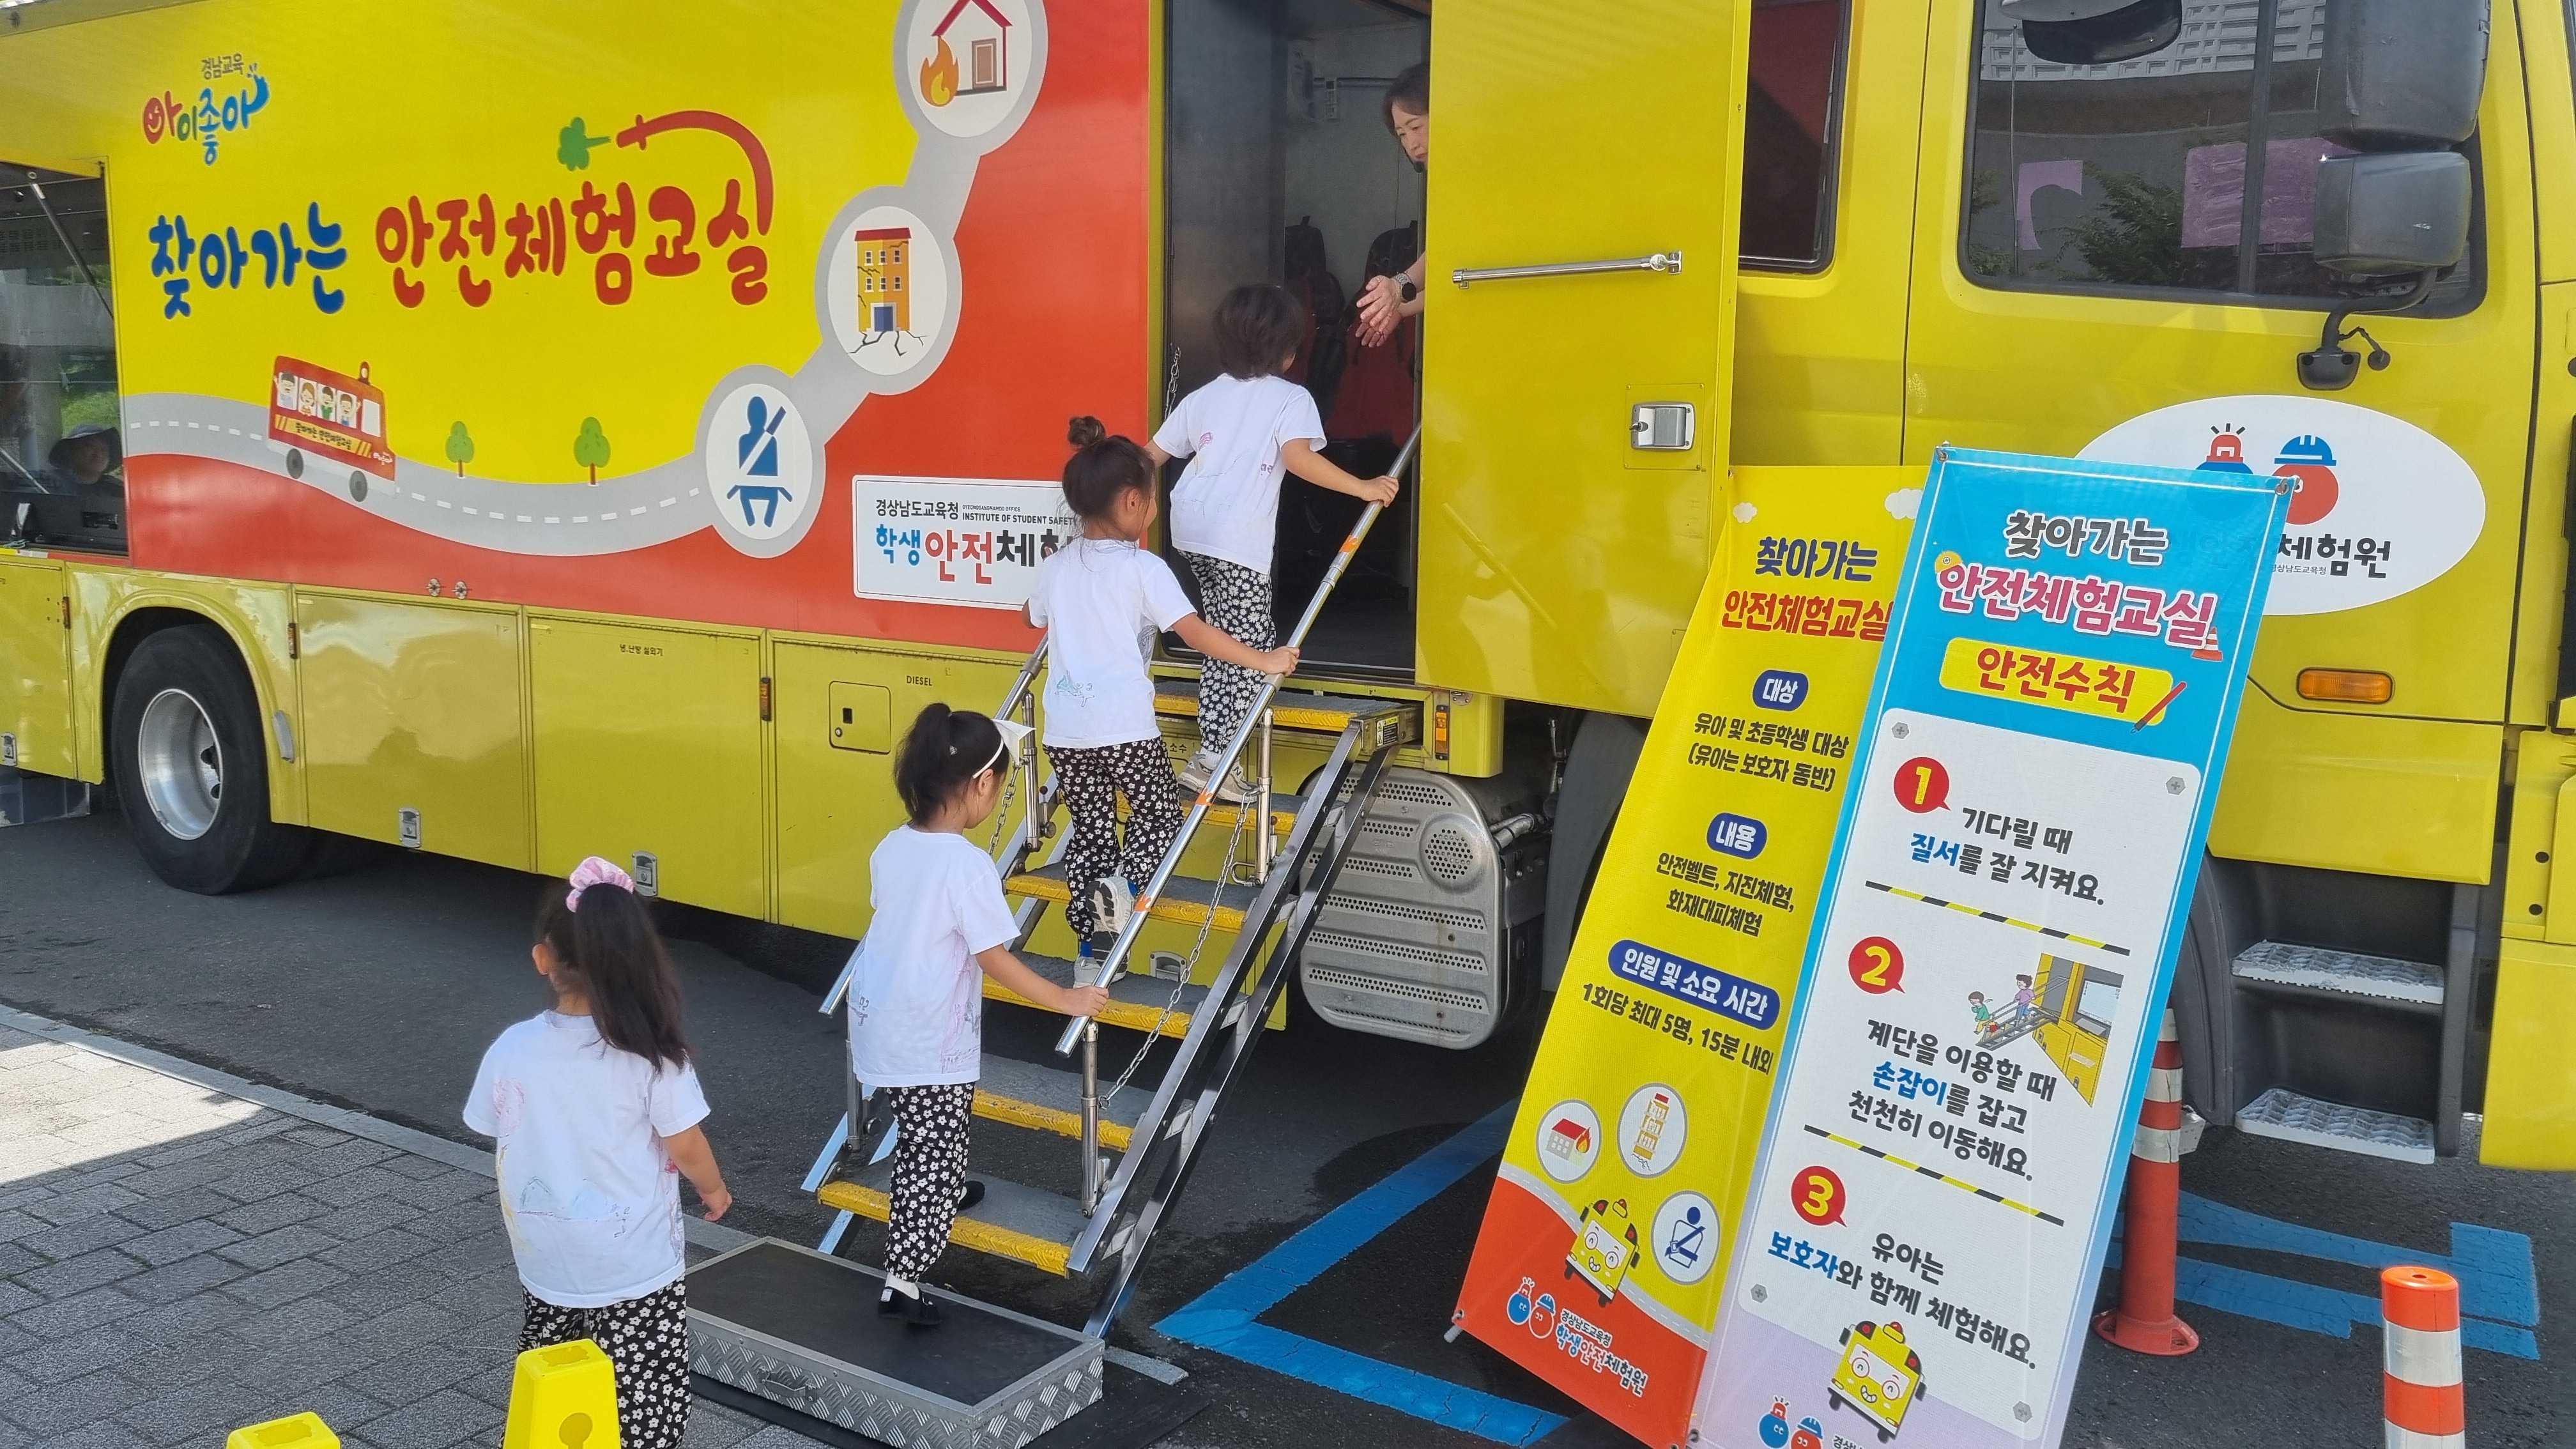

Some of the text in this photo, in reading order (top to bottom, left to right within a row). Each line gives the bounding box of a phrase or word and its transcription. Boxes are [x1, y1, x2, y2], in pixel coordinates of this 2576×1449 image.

[201, 53, 244, 79] 경남교육
[143, 73, 270, 165] 아이좋아
[149, 111, 773, 319] 찾아가는 안전체험교실
[876, 499, 958, 520] 경상남도교육청
[962, 512, 1073, 525] INSTITUTE OF STUDENT SAFET
[1755, 537, 1878, 581] 찾아가는
[2004, 512, 2168, 564] 찾아가는
[1721, 590, 1894, 641] 안전체험교실
[1937, 564, 2218, 648] 안전체험교실
[907, 676, 933, 686] DIESEL
[1762, 678, 1798, 703] 대상
[1978, 648, 2135, 713] 안전수칙
[1694, 713, 1850, 759] 유아 및 초등학생 대상
[1688, 742, 1836, 791] (유아는 보호자 동반)
[1915, 767, 1931, 804] 1
[1715, 821, 1756, 852] 내용
[1963, 808, 2073, 854] 기다릴 때
[1656, 853, 1795, 912] 안전벨트, 지진체험,
[1910, 833, 2104, 905] 질서를 잘 지켜요.
[1666, 889, 1763, 937] 화재대피체험
[1621, 948, 1768, 1021] 인원 및 소요 시간
[1861, 946, 1890, 986] 2
[1583, 983, 1774, 1075] 1회당 최대 5명, 15분 내외
[1867, 1020, 2057, 1101] 계단을 이용할 때
[1872, 1061, 2027, 1133] 손잡이를 잡고
[1849, 1091, 2032, 1181] 천천히 이동해요.
[1802, 1176, 1833, 1216] 3
[1871, 1233, 1944, 1285] 유아는
[1768, 1231, 2035, 1369] 보호자와 함께 체험해요.
[1561, 1310, 1611, 1347] 경상남도교육청
[1557, 1324, 1646, 1396] 학생안전체험원
